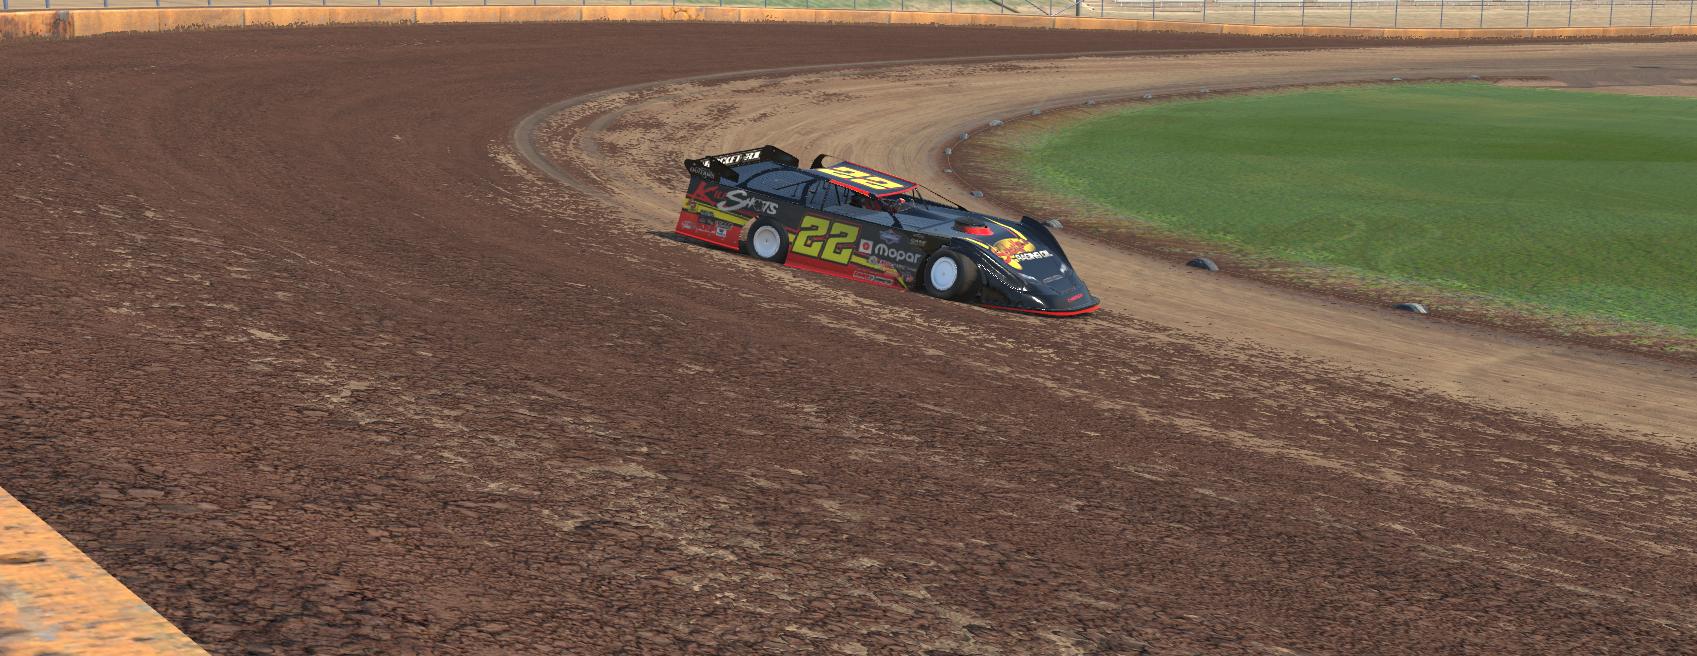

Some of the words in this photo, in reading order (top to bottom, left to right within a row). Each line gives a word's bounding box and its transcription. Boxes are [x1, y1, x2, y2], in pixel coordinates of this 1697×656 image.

[816, 166, 904, 190] 22
[792, 215, 860, 265] 22
[874, 243, 921, 264] Mopar
